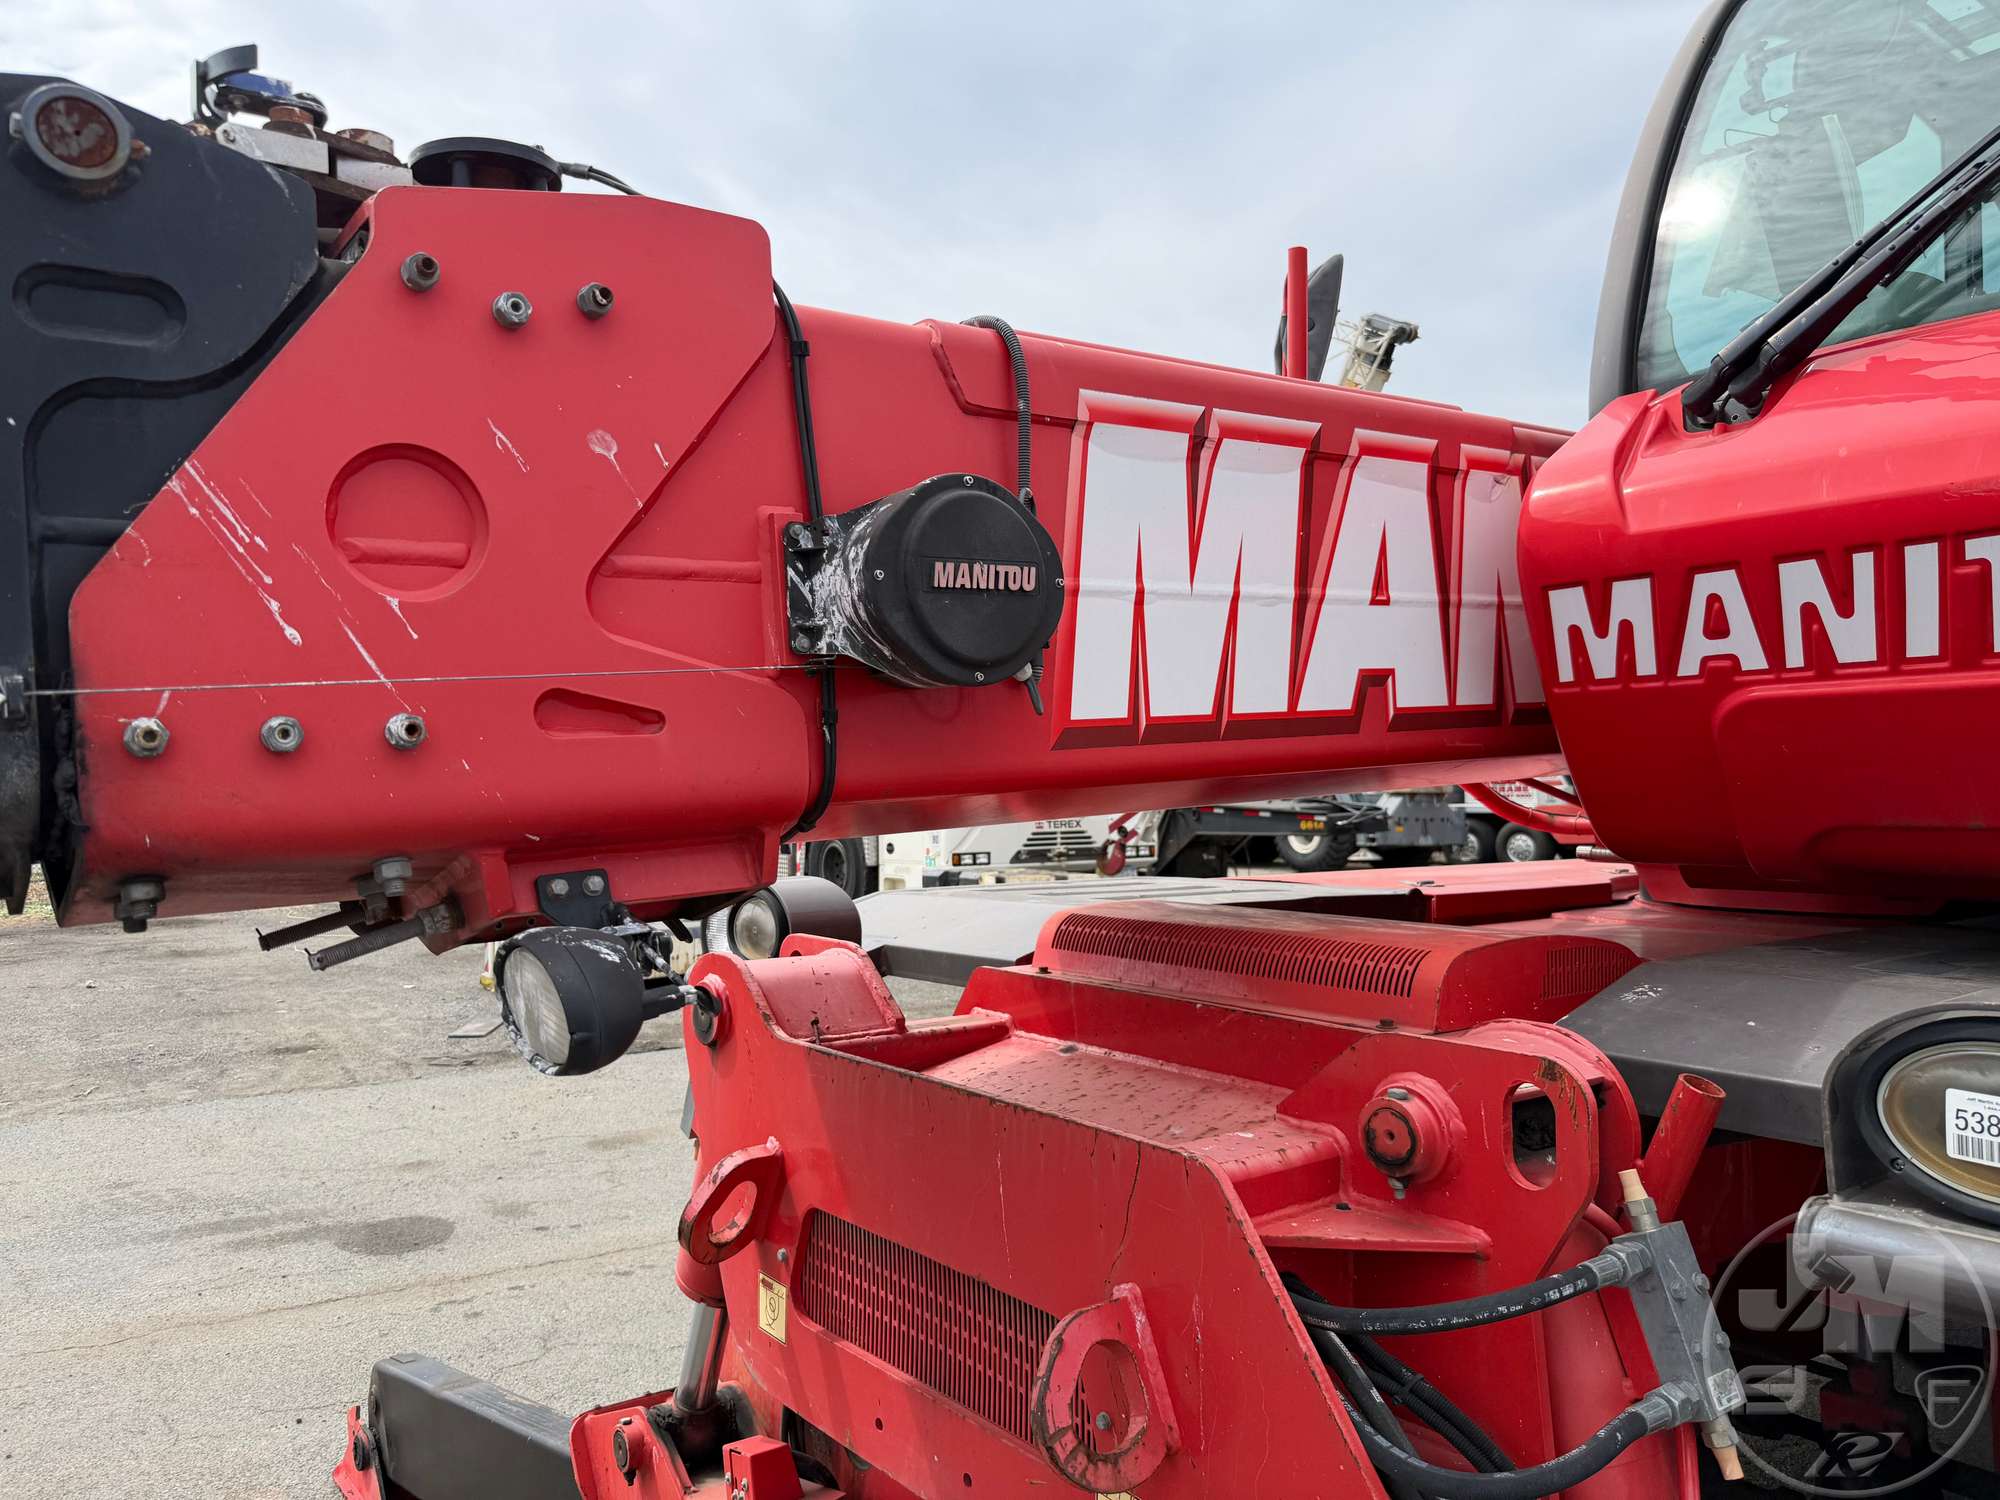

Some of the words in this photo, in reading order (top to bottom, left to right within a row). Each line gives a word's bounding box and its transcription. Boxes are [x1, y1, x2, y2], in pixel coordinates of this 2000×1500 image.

[933, 560, 1037, 592] MANITOU
[1046, 819, 1082, 829] TEREX
[1954, 1108, 2000, 1138] 538
